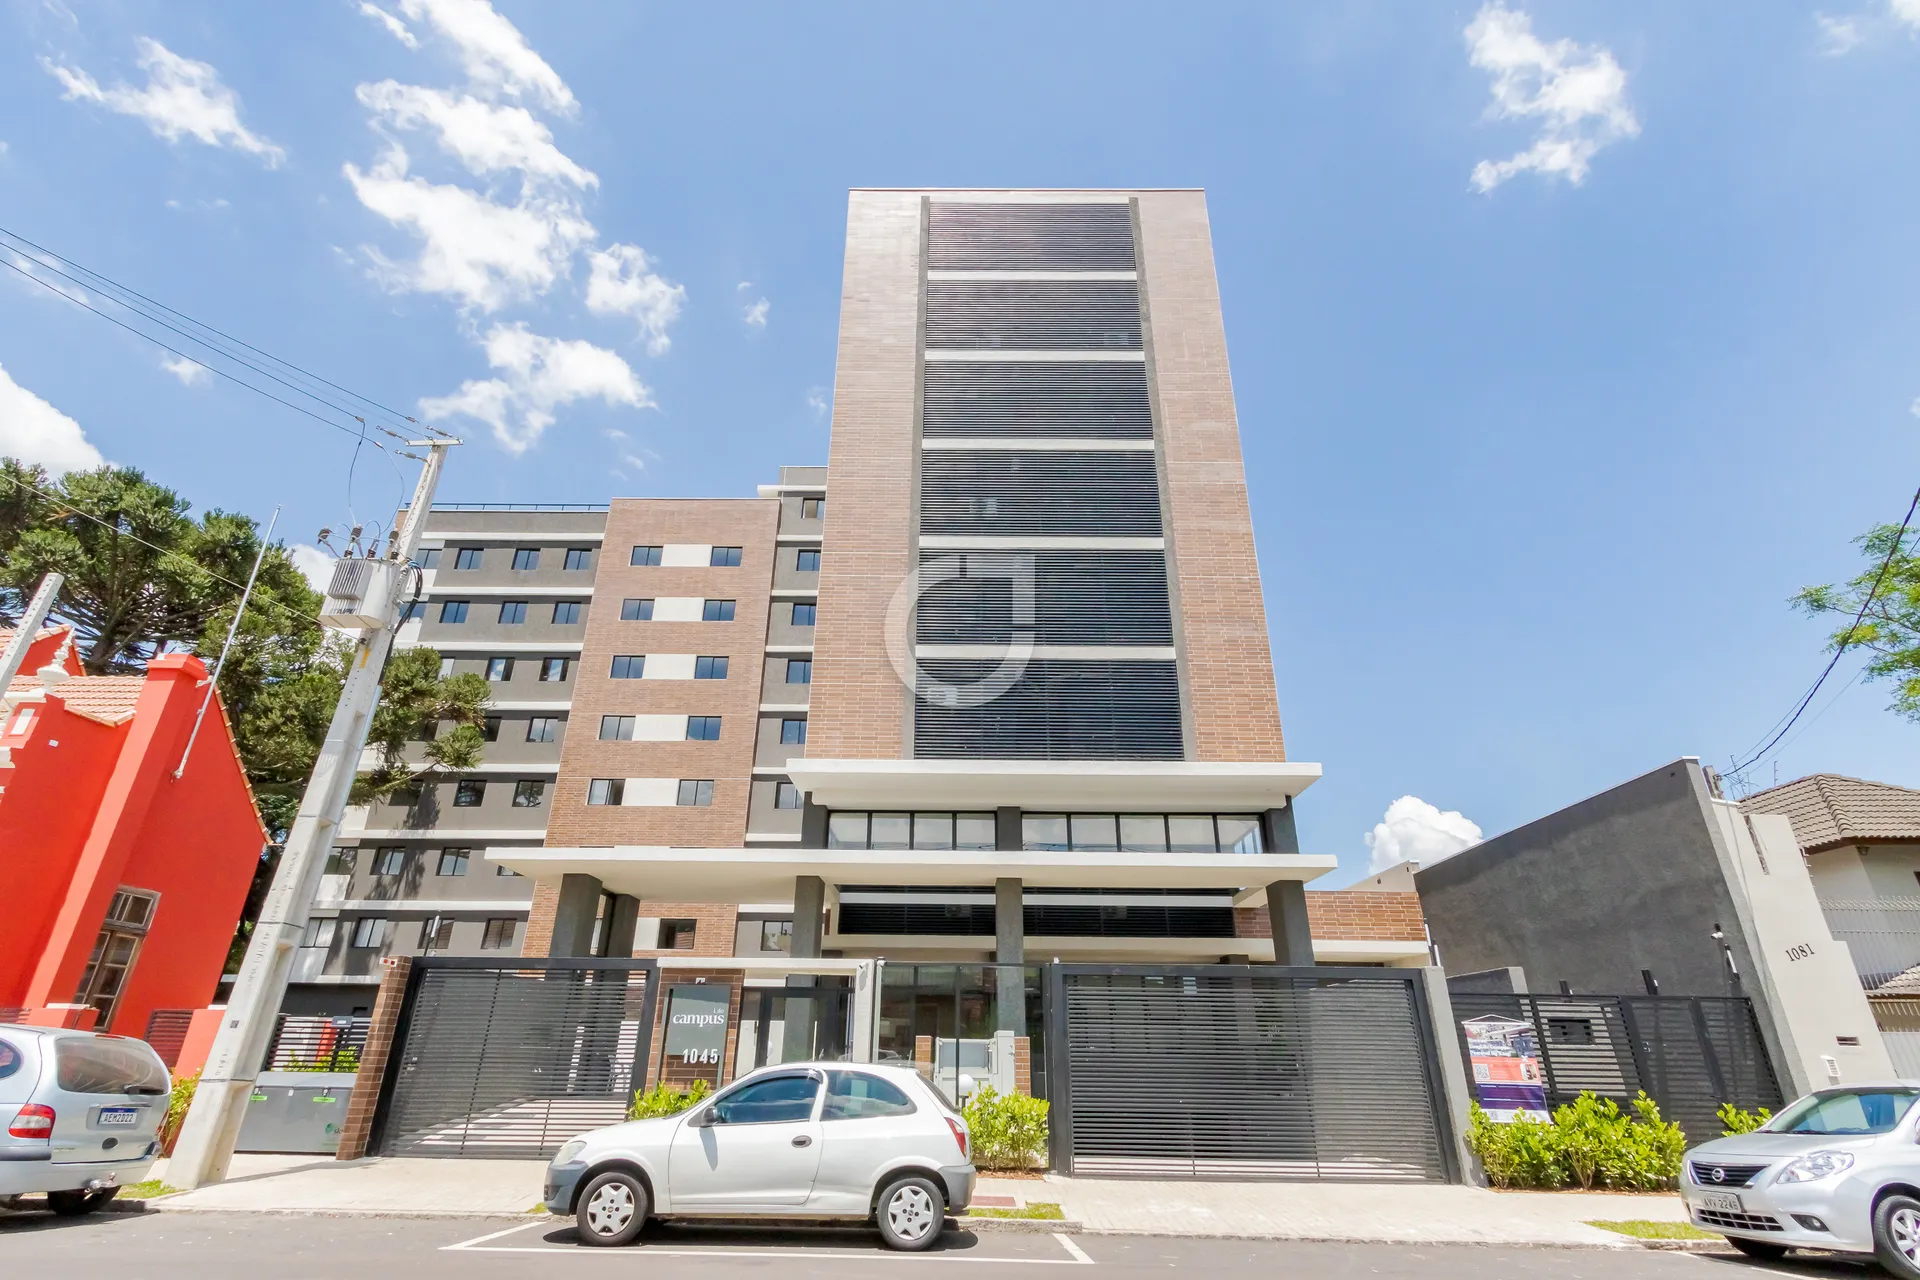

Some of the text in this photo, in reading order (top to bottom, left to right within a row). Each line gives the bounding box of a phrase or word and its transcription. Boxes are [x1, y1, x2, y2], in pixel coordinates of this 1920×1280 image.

[1785, 943, 1815, 962] 1081
[672, 1013, 725, 1027] campus
[682, 1048, 719, 1064] 1045
